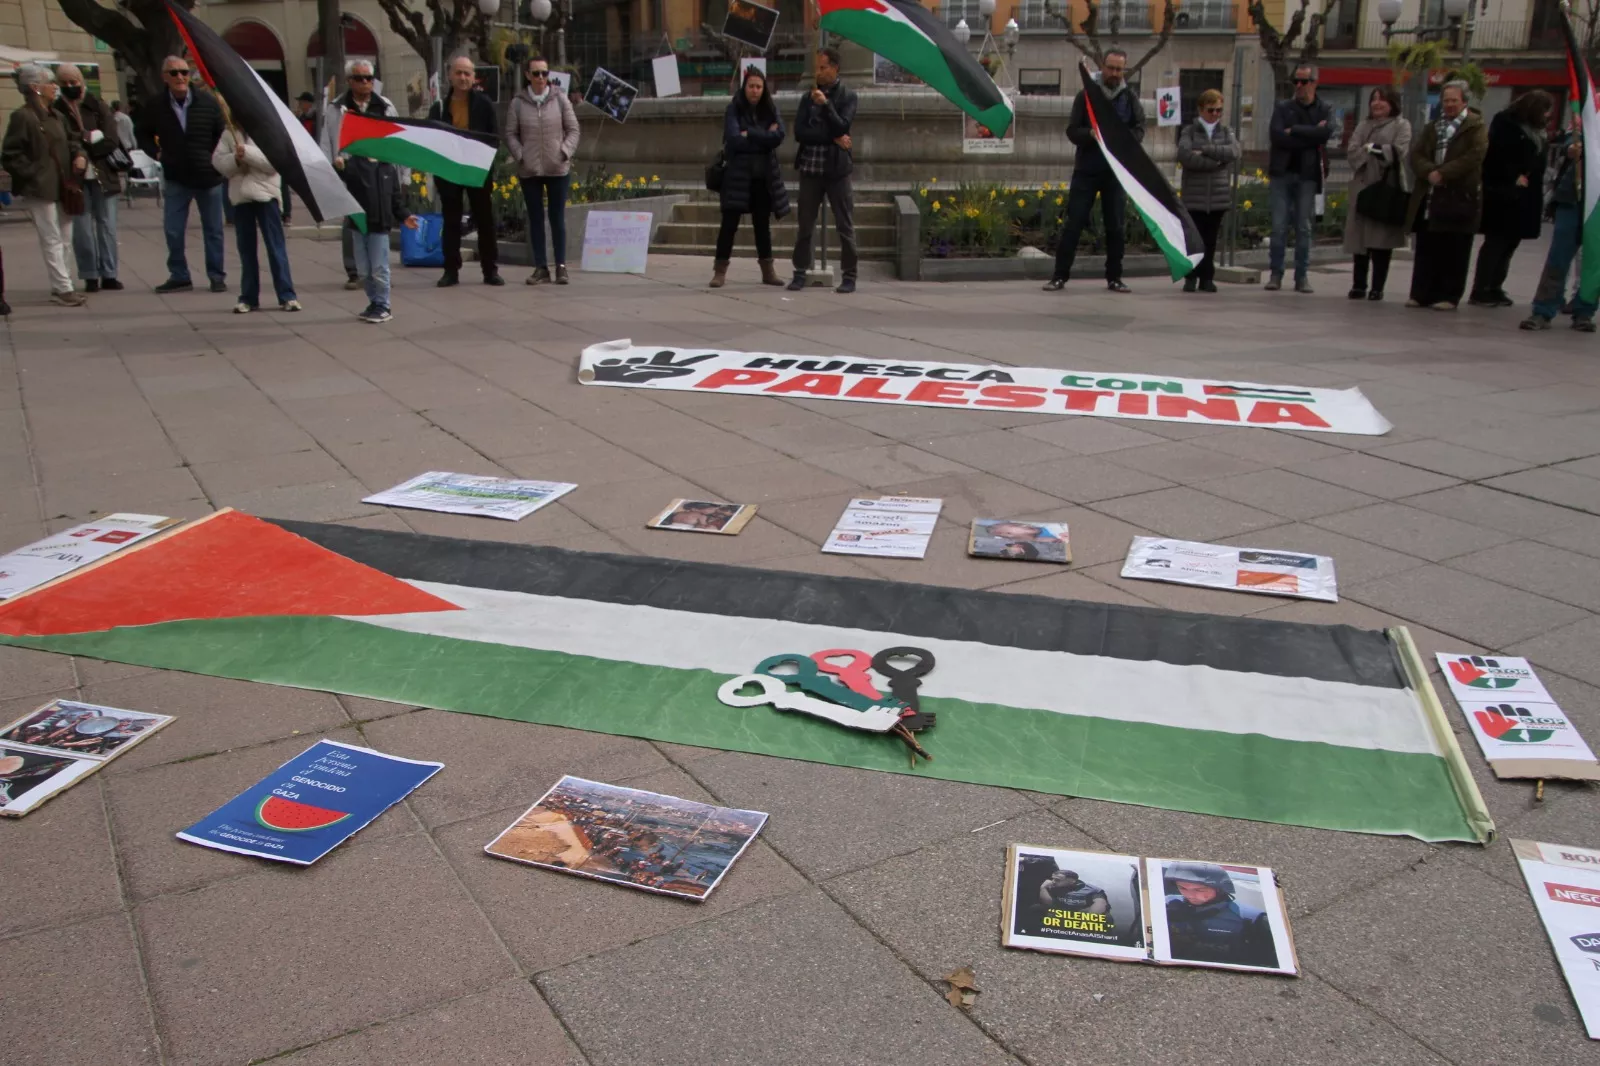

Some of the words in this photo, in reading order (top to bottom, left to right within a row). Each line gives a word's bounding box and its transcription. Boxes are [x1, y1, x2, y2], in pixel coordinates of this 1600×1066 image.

[744, 357, 1015, 383] HUESCA
[1061, 375, 1184, 394] CON
[693, 368, 1332, 428] PALESTINA
[1519, 717, 1565, 725] STOP
[326, 750, 350, 760] Esta
[308, 763, 351, 777] condena
[314, 756, 357, 770] persona
[291, 775, 346, 793] GENOCIDIO
[272, 788, 300, 800] GAZA
[219, 832, 258, 844] GENOCIDE
[264, 842, 285, 850] GAZA
[1560, 852, 1600, 864] BOI
[1043, 916, 1061, 927] OR
